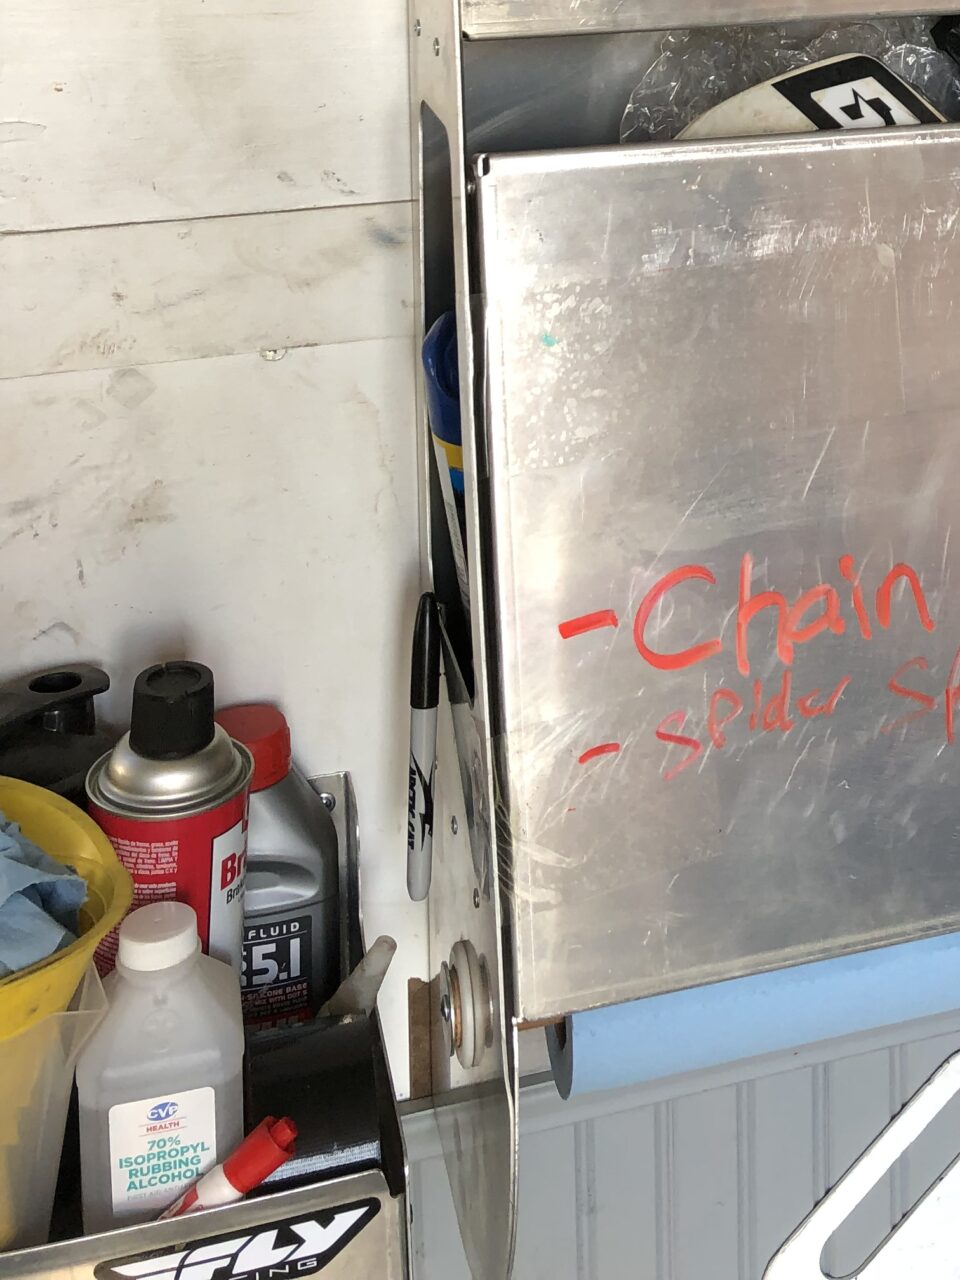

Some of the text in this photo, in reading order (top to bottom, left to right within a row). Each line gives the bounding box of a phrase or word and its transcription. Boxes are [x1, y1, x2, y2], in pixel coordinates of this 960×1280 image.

[633, 551, 935, 676] Chain
[248, 921, 300, 940] FLUID
[147, 1102, 178, 1119] CVP
[146, 1121, 180, 1133] HEALTH
[147, 1135, 181, 1151] 70%
[119, 1142, 210, 1169] ISOPROPYL
[127, 1166, 204, 1192] ALCOHOL
[128, 1156, 202, 1180] RUBBING
[111, 1205, 371, 1280] FLY
